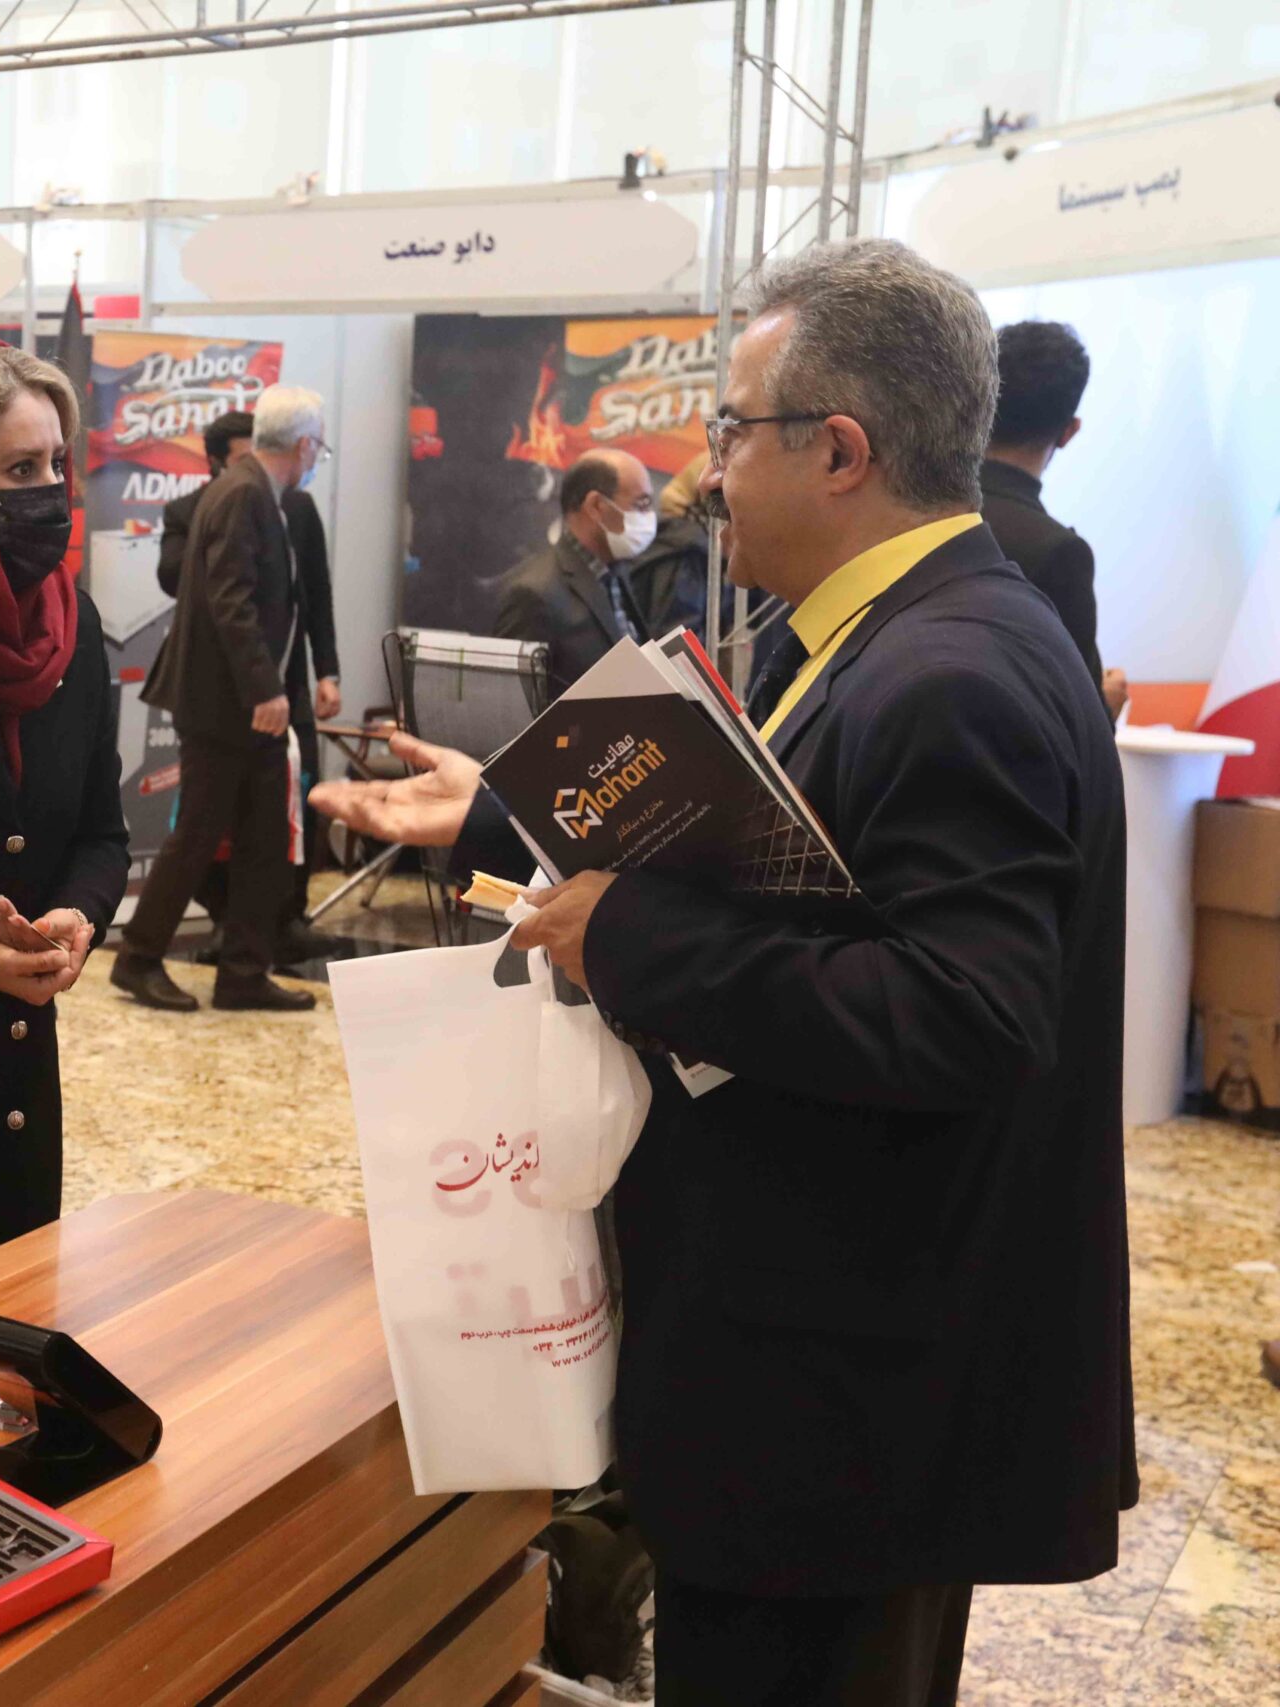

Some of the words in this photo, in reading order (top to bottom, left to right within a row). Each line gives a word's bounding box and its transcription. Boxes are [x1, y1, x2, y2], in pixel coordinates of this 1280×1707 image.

[383, 236, 446, 261] صنعت
[451, 229, 495, 265] دابو
[124, 352, 248, 392] Daboo
[600, 330, 719, 384] Dab
[590, 371, 718, 441] San
[587, 734, 635, 778] مهانیت
[562, 738, 668, 830] Mahanit
